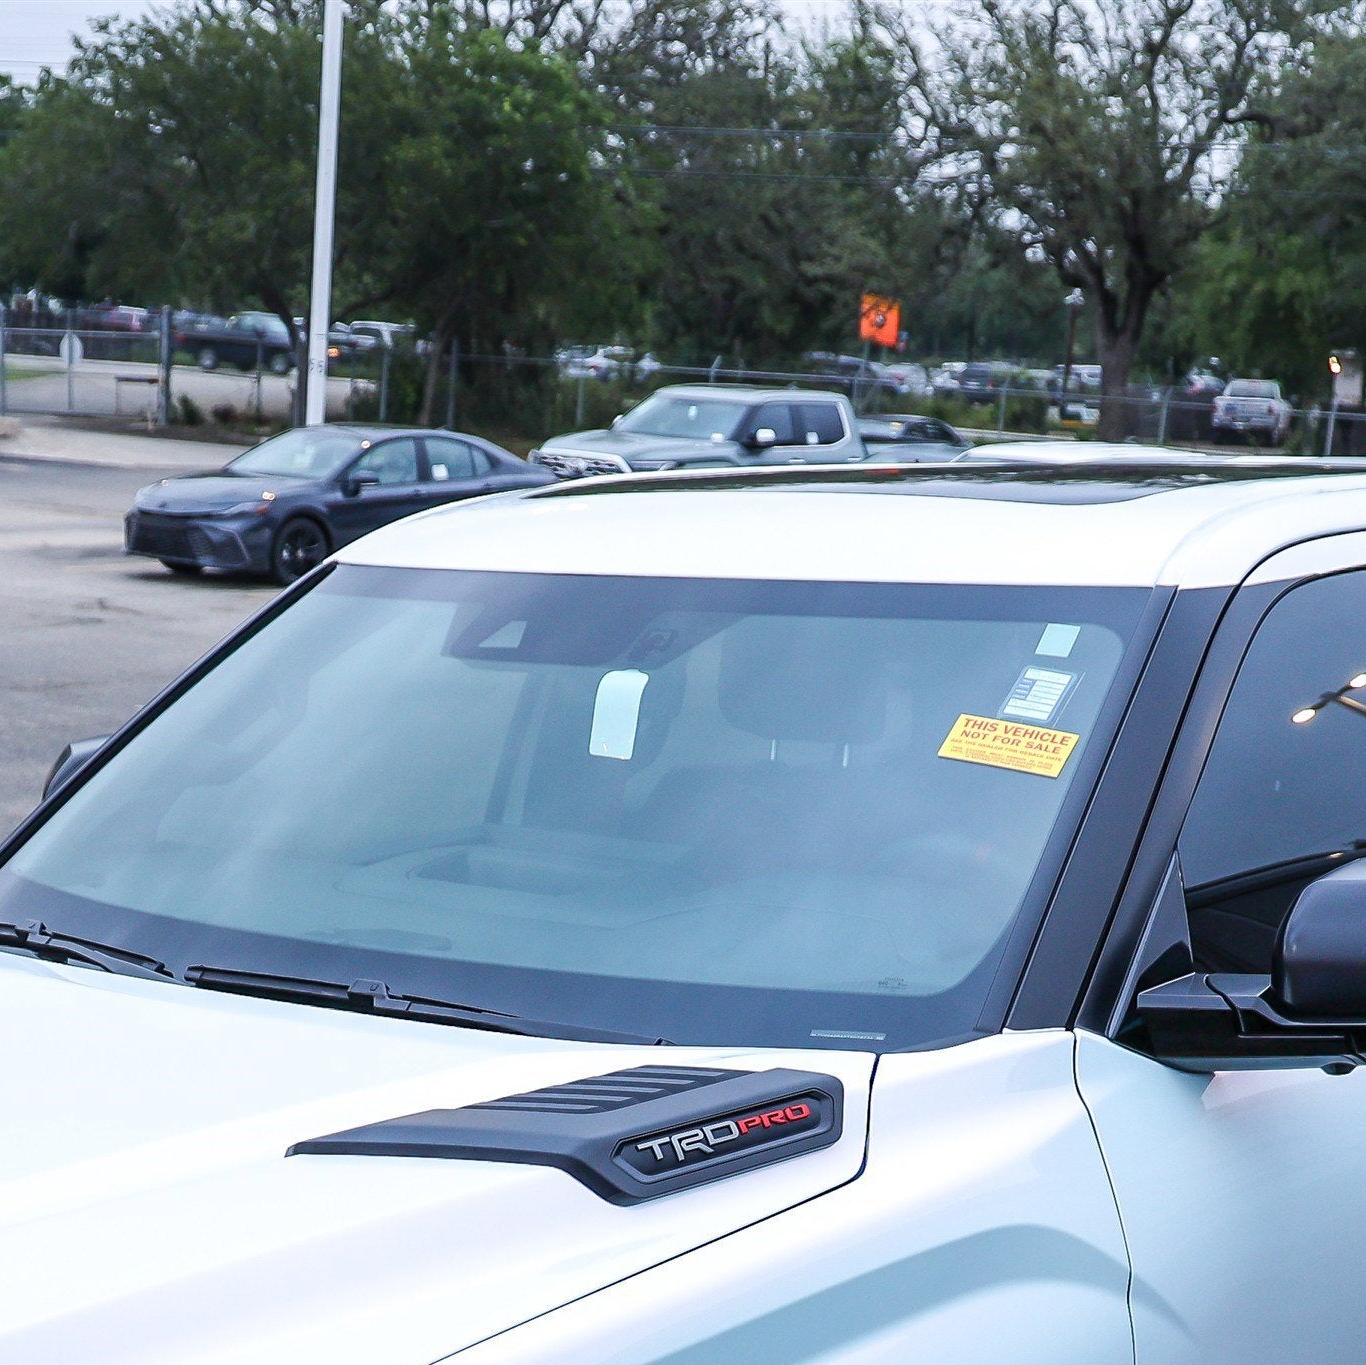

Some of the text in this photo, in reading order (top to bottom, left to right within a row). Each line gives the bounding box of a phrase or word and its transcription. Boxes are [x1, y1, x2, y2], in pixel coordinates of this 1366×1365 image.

[960, 730, 1061, 754] NOT FOR SALE
[963, 718, 1072, 746] THIS VEHICLE
[636, 1102, 811, 1161] TRD PRO
